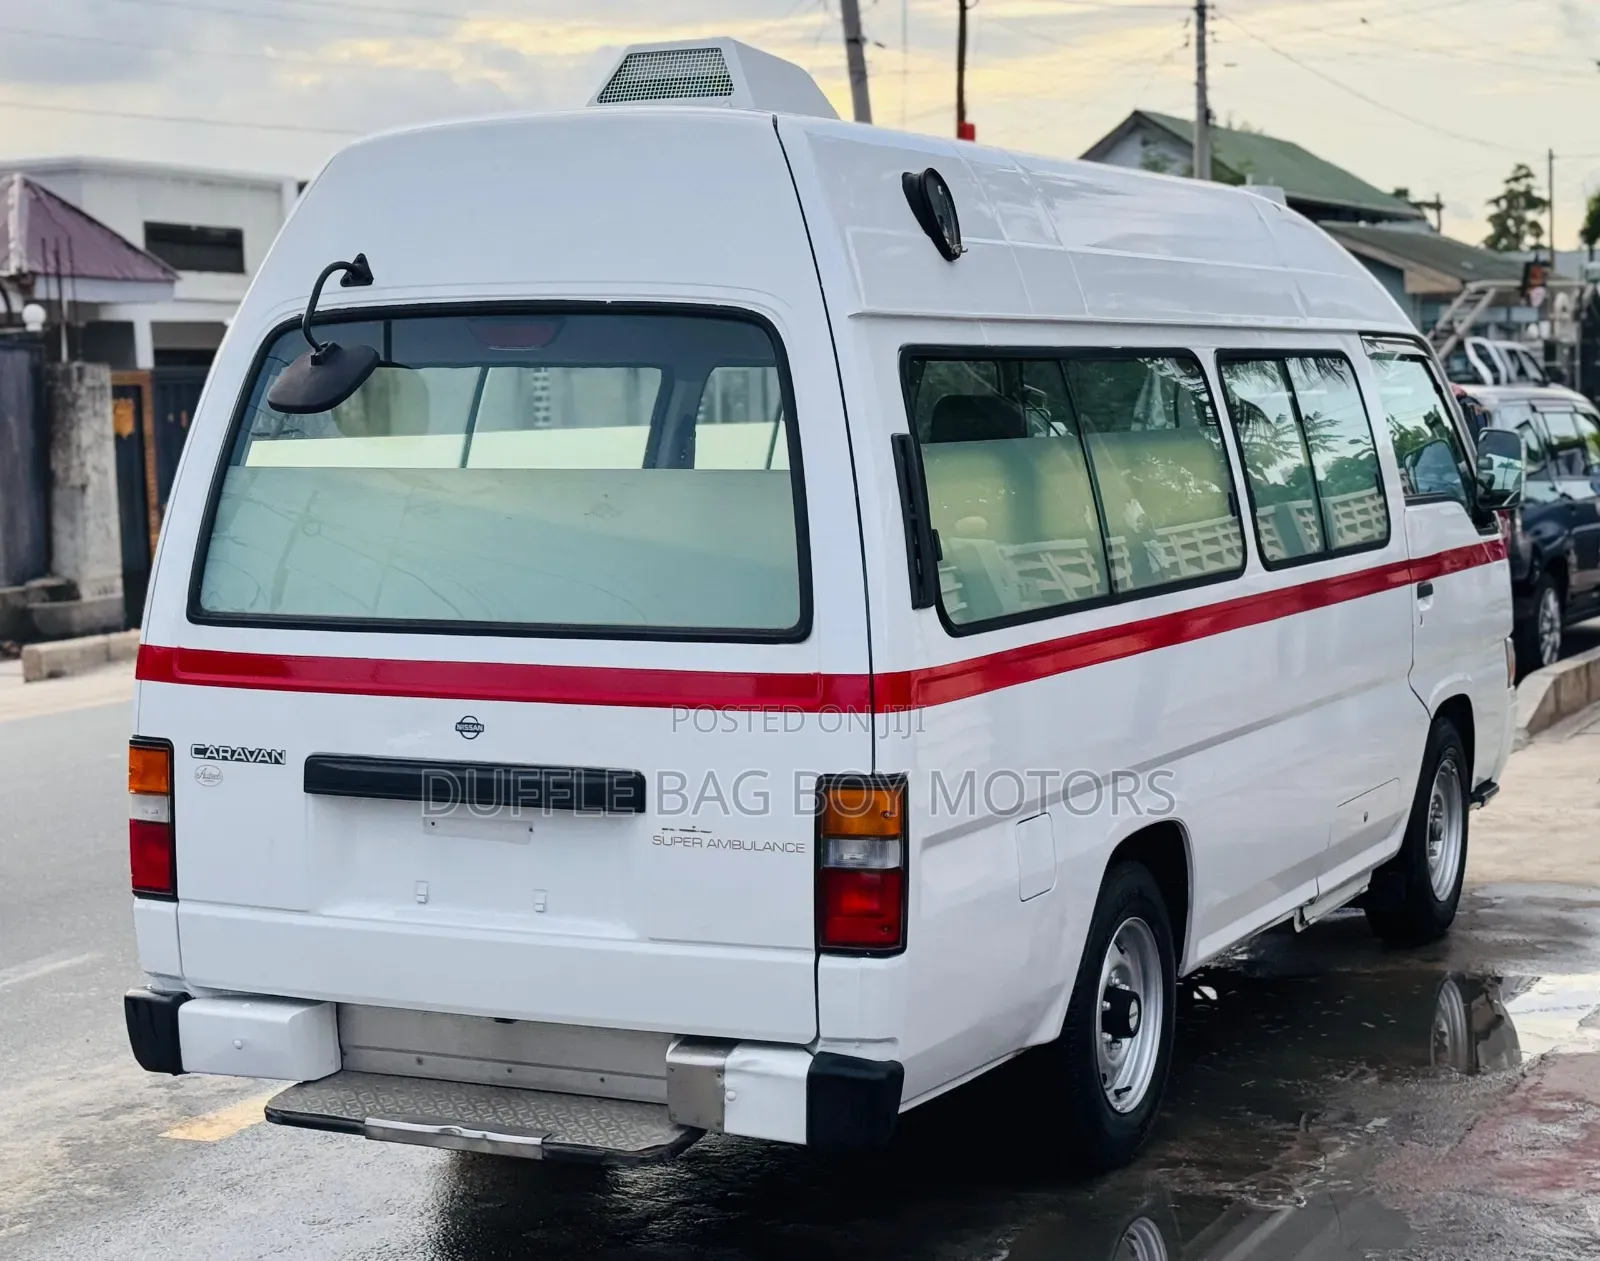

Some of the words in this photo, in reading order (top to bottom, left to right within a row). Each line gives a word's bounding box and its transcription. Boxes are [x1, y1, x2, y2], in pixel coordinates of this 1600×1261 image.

[456, 723, 484, 731] NISSAN
[190, 743, 286, 765] CARAVAN
[652, 835, 703, 848] SUPER
[706, 838, 805, 853] AMBULANCE
